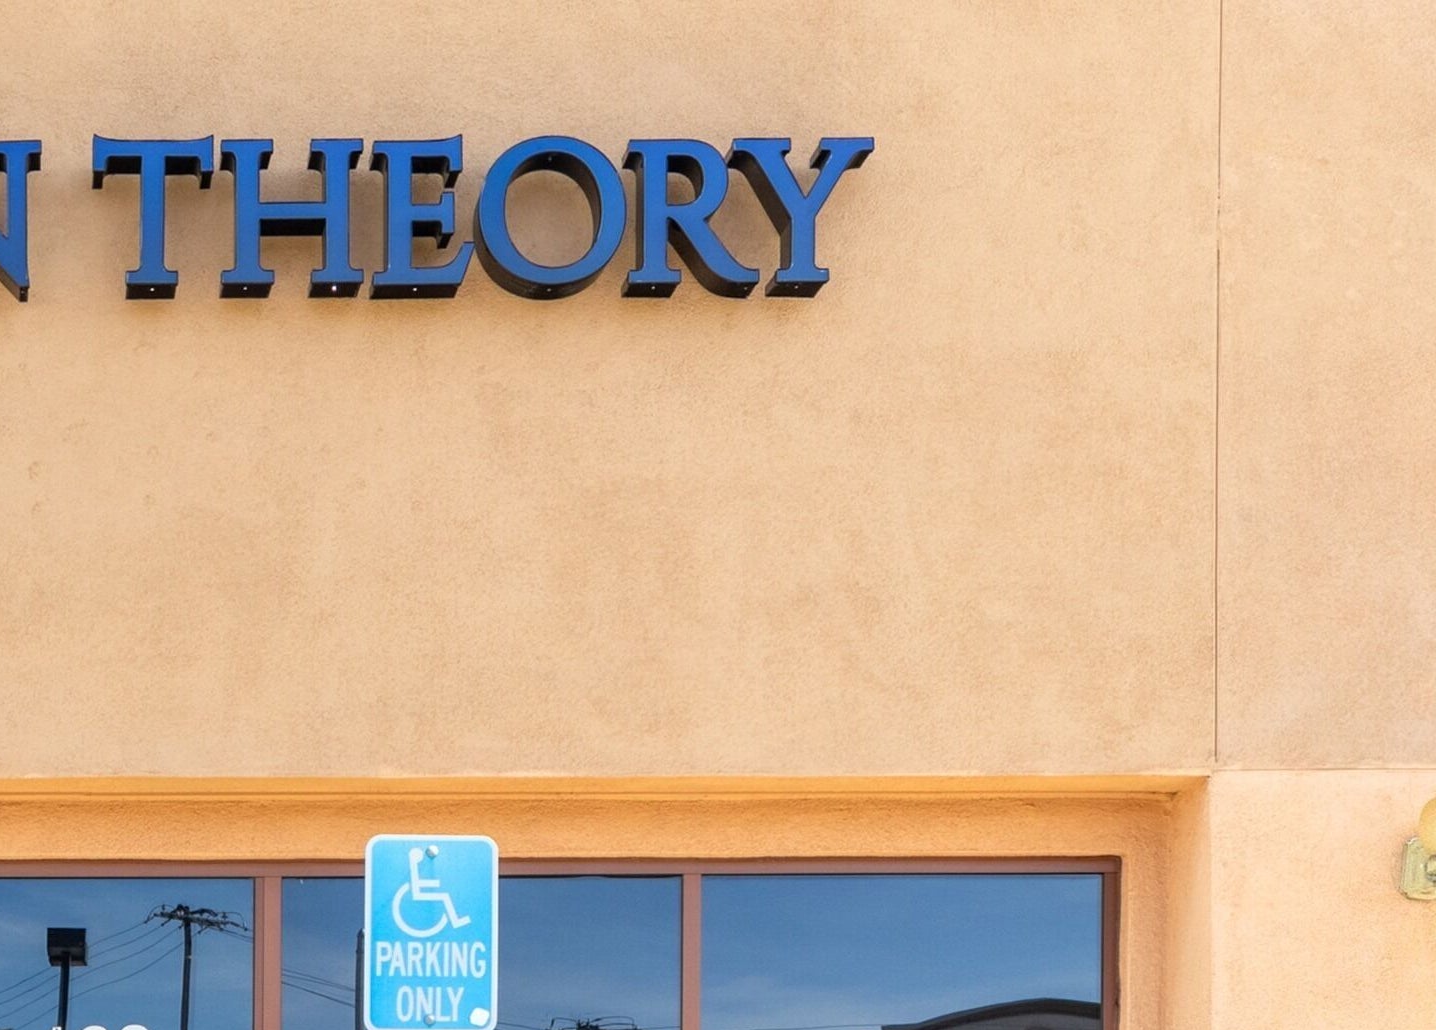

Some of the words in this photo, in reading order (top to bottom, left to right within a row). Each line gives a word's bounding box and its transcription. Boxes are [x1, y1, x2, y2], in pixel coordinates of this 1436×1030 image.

[91, 135, 874, 298] THEORY
[375, 940, 487, 979] PARKING
[395, 987, 464, 1023] ONLY
